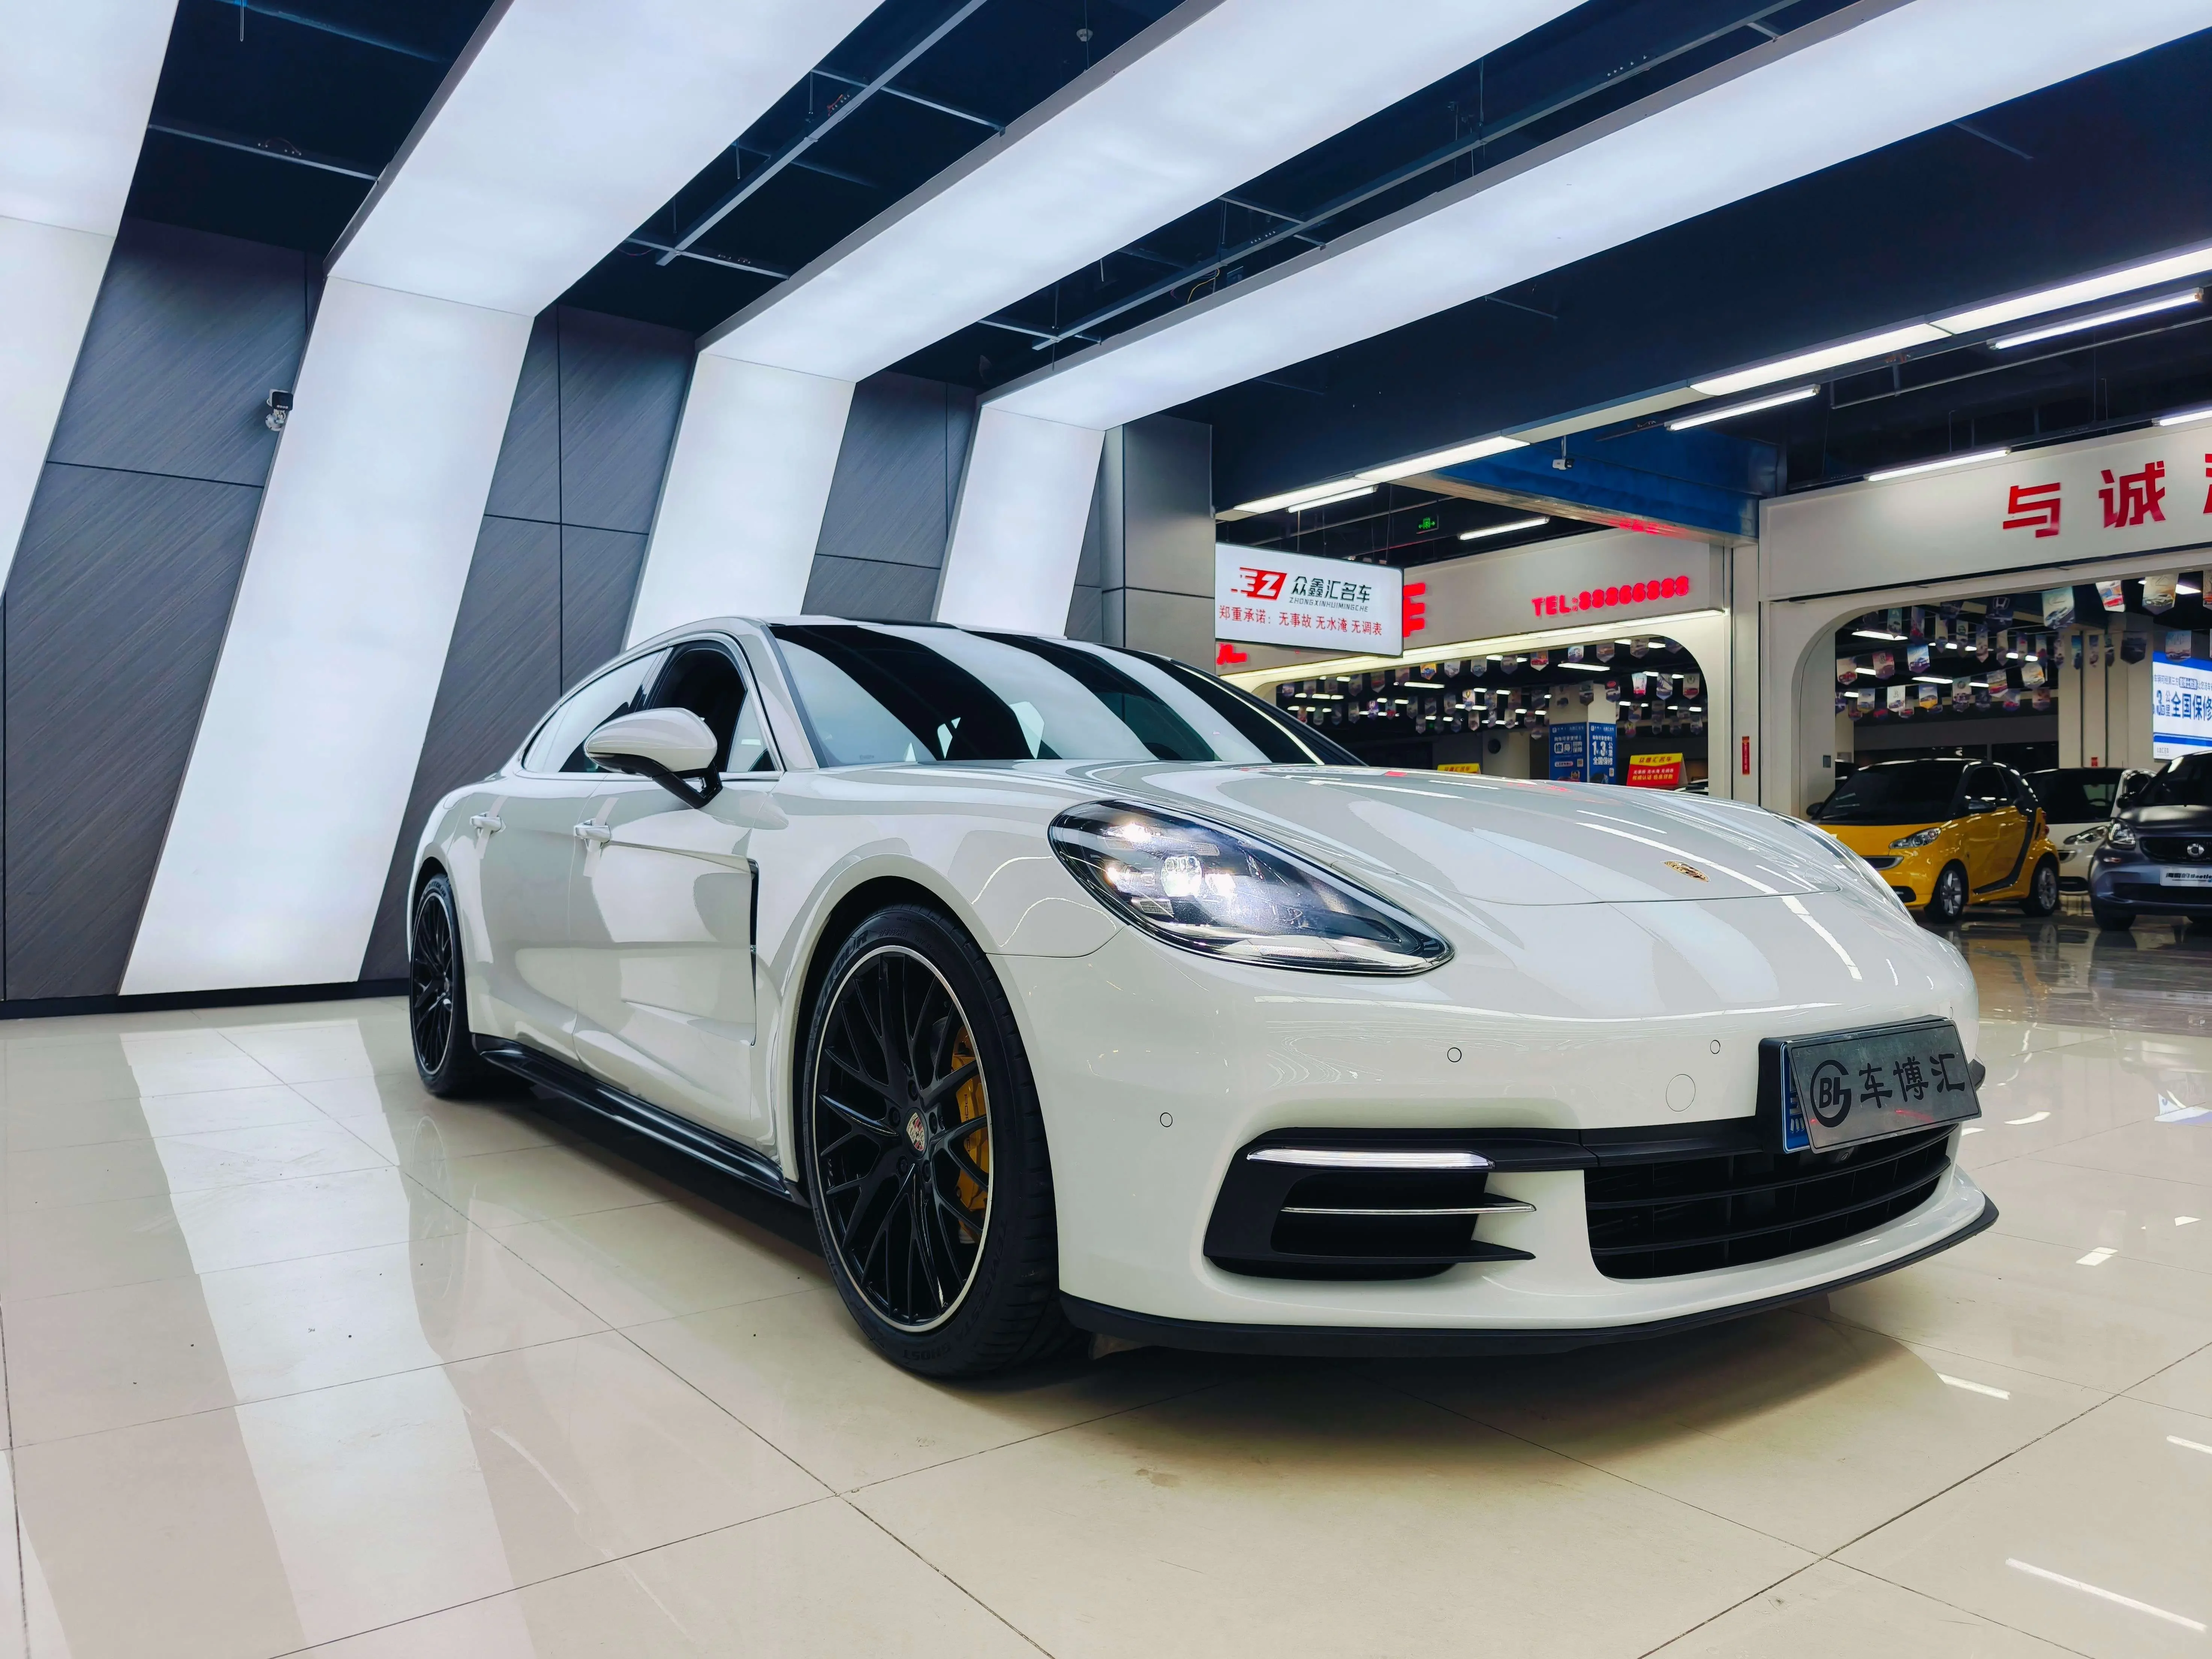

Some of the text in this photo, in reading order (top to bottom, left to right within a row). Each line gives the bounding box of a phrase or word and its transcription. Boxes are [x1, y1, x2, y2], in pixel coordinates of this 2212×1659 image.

[2003, 453, 2212, 538] 与诚
[1289, 597, 1369, 612] ZHONGXINHUIMINGCHE
[1291, 576, 1372, 603] 众鑫汇名车
[1219, 605, 1382, 636] 郑重承诺： 无事故 无水淹 无调表
[1858, 1053, 1965, 1108] 车博汇
